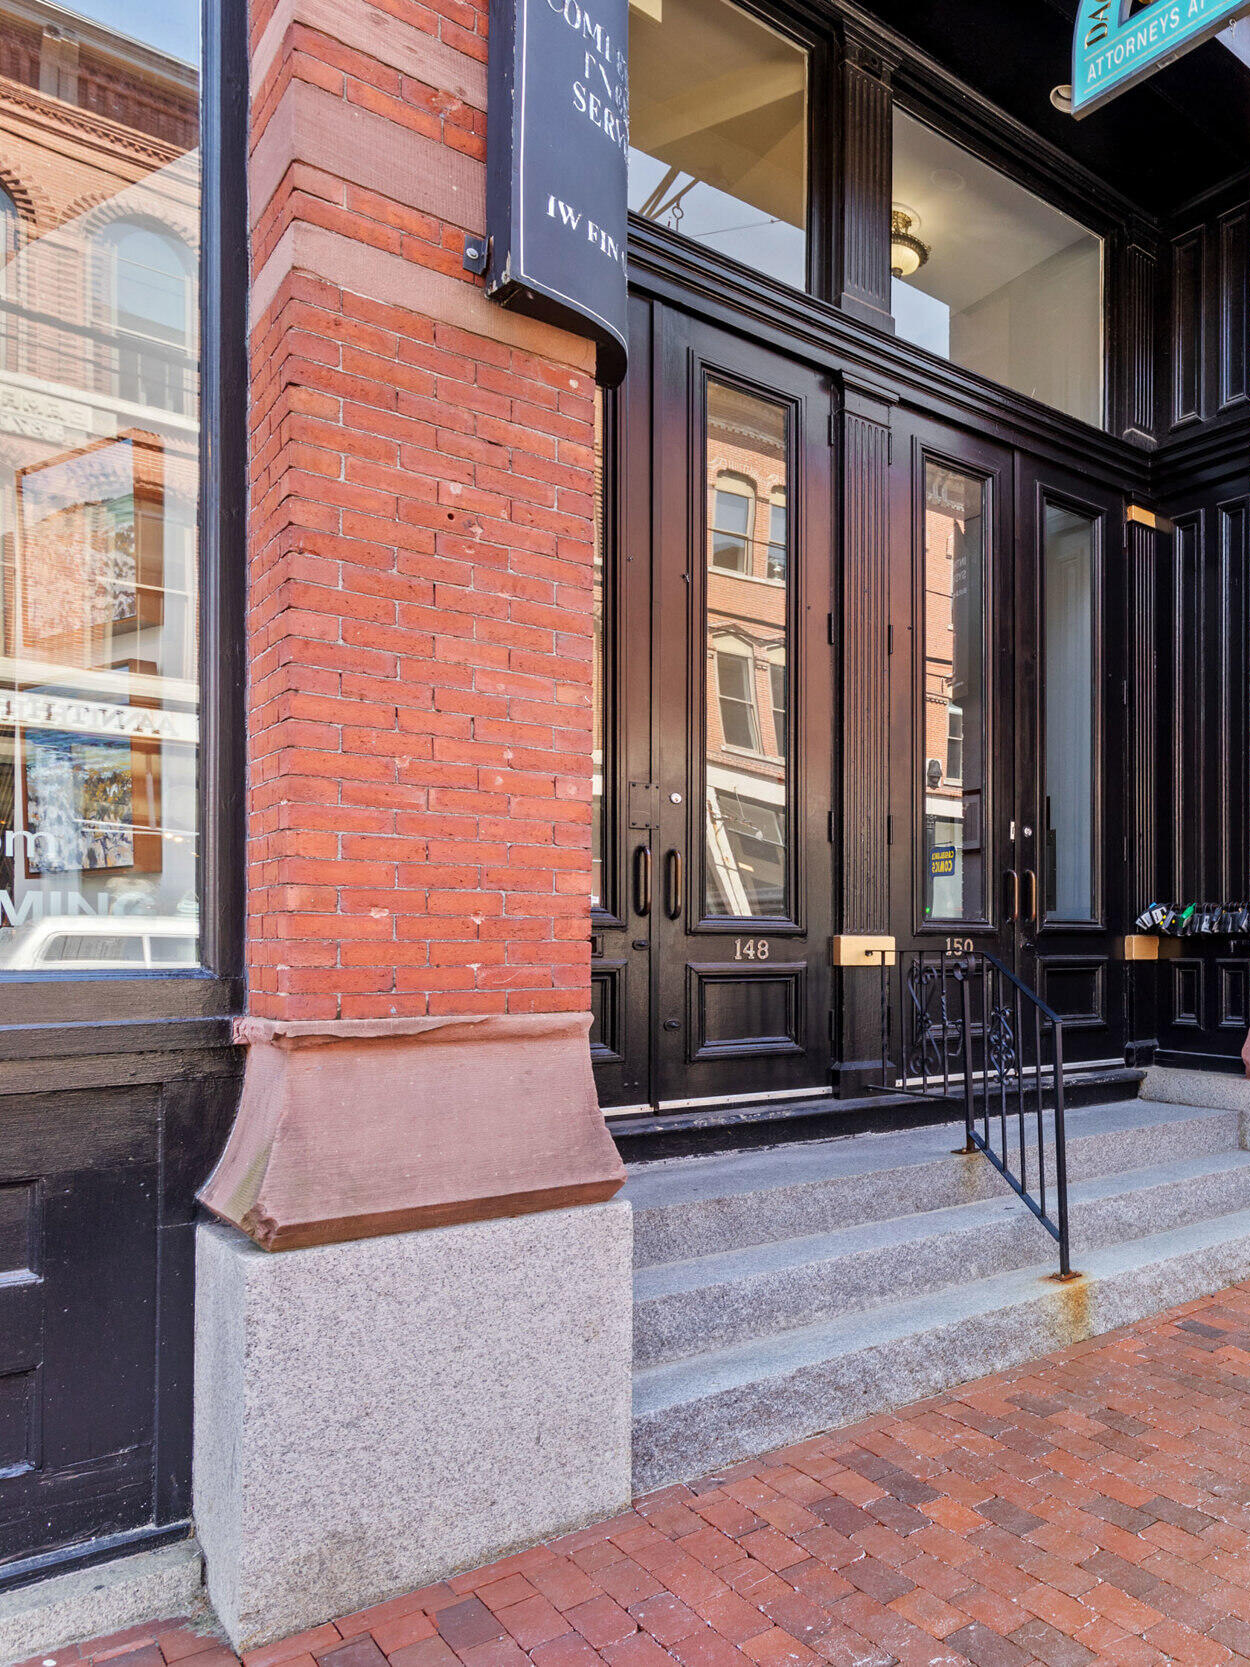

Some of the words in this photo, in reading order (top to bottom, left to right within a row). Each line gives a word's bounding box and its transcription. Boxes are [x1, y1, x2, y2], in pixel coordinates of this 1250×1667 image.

[1084, 0, 1113, 50] DA
[1087, 6, 1180, 83] ATTORNEYS
[546, 194, 582, 230] IW
[587, 220, 629, 274] FIN
[734, 938, 770, 960] 148
[945, 937, 975, 957] 150
